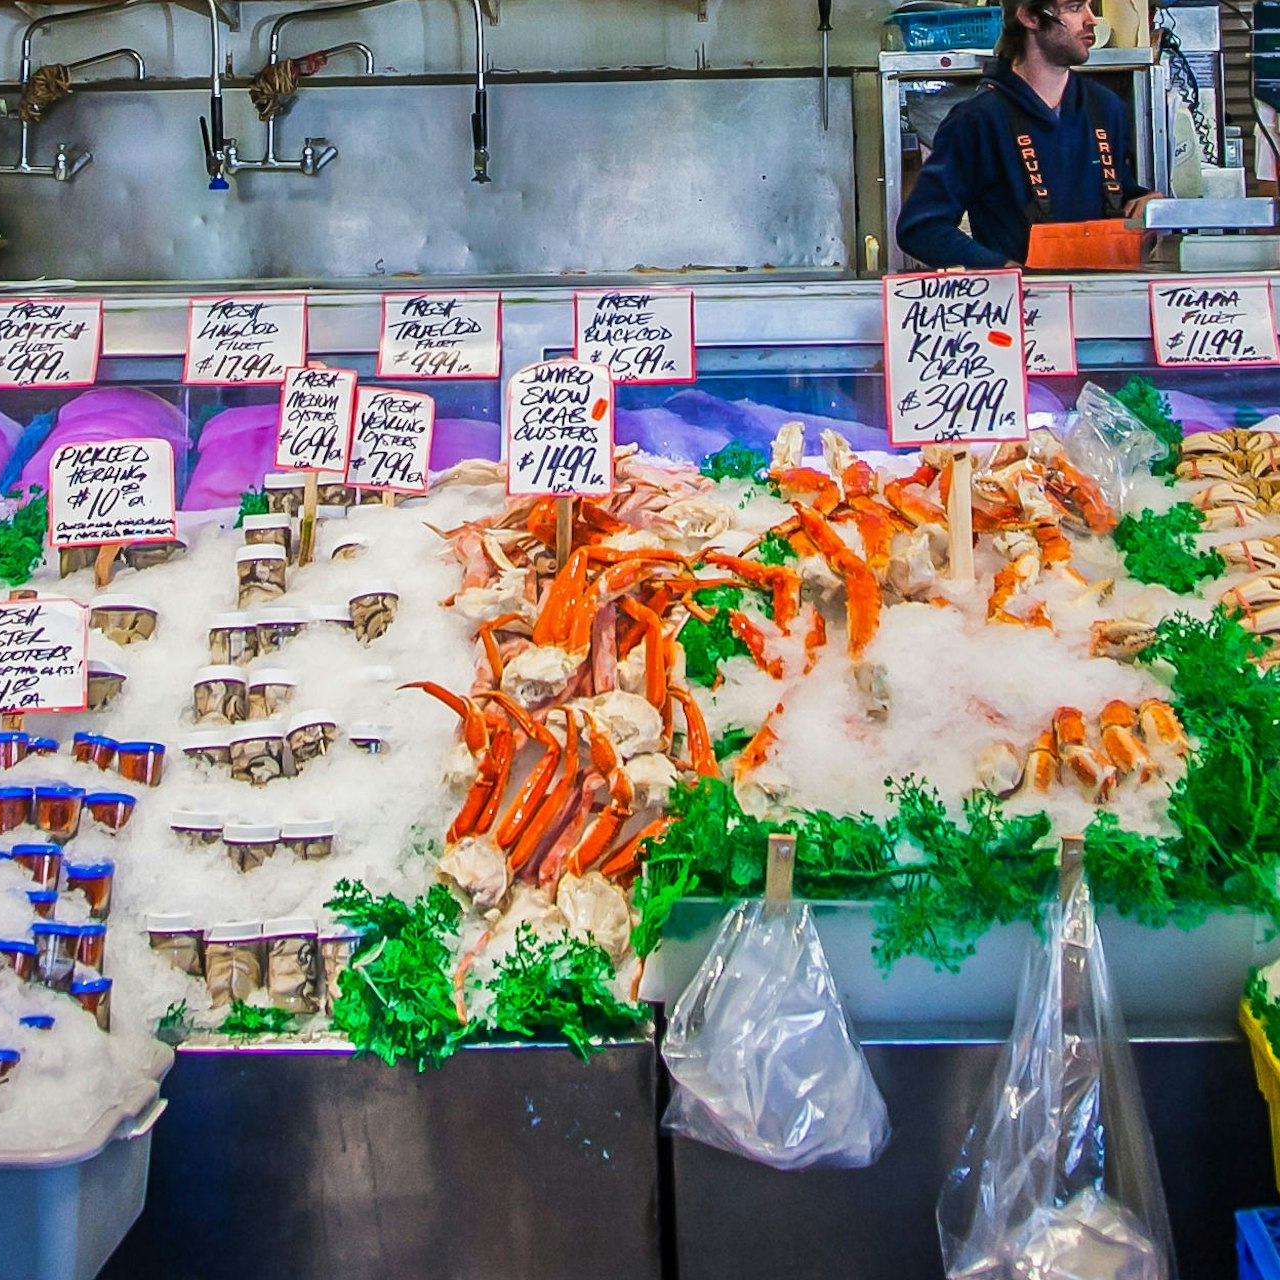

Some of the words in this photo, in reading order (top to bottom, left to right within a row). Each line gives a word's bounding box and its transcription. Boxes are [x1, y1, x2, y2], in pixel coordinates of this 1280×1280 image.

[894, 277, 990, 300] JUMBO
[1159, 287, 1241, 309] TILAPIA
[7, 303, 65, 319] FRESH
[593, 312, 655, 329] WHOLE
[902, 293, 1014, 330] ALASKAN
[907, 331, 980, 363] KING
[520, 365, 594, 386] JUMBO
[920, 355, 995, 382] CRAB
[292, 370, 346, 388] FRESH
[286, 392, 339, 410] MEDIUM
[368, 394, 424, 414] FRESH
[520, 386, 592, 406] SNOW
[360, 411, 426, 441] YEARLING
[523, 407, 587, 425] CRAB
[362, 431, 418, 450] OYSTERS
[514, 425, 599, 444] CLUSTERS
[67, 465, 148, 487] HERRING
